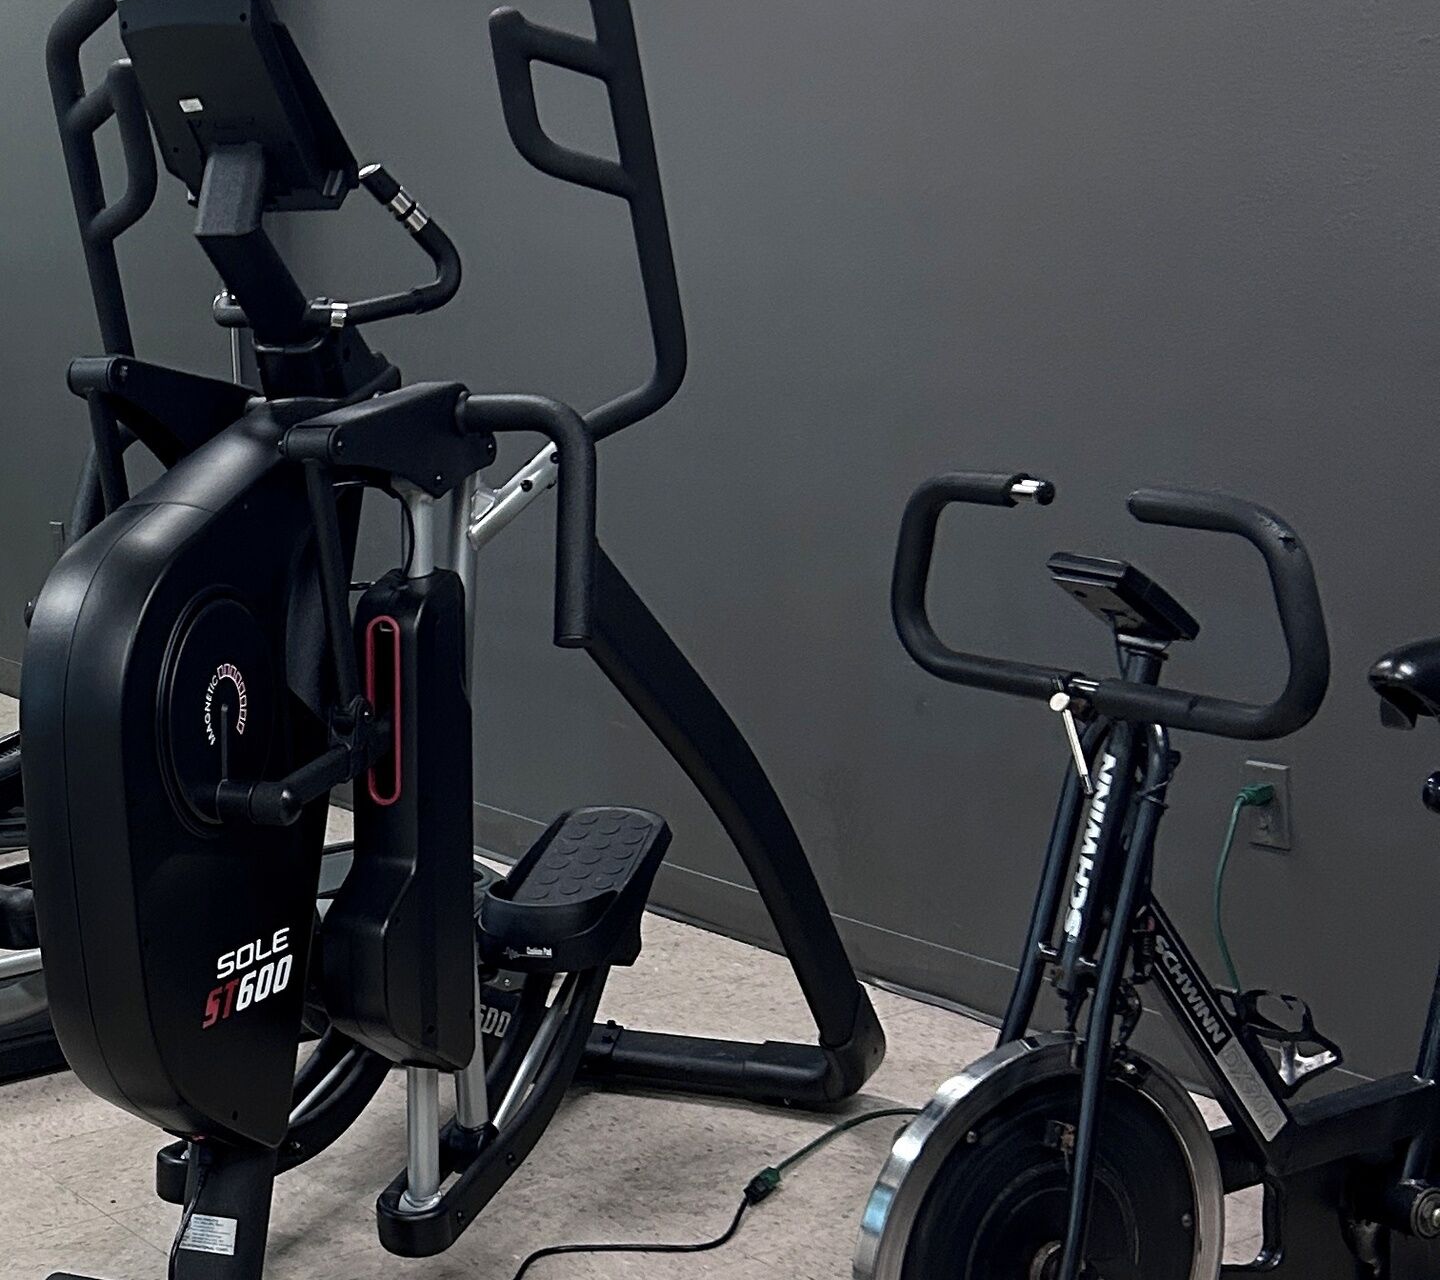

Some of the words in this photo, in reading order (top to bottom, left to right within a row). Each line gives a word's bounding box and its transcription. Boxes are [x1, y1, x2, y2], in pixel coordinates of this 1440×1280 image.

[204, 674, 219, 746] MAGNETIC
[1063, 754, 1116, 943] SCHWINN
[216, 927, 290, 979] SOLE
[1155, 934, 1227, 1045] SCHWINN
[202, 954, 293, 1029] ST600
